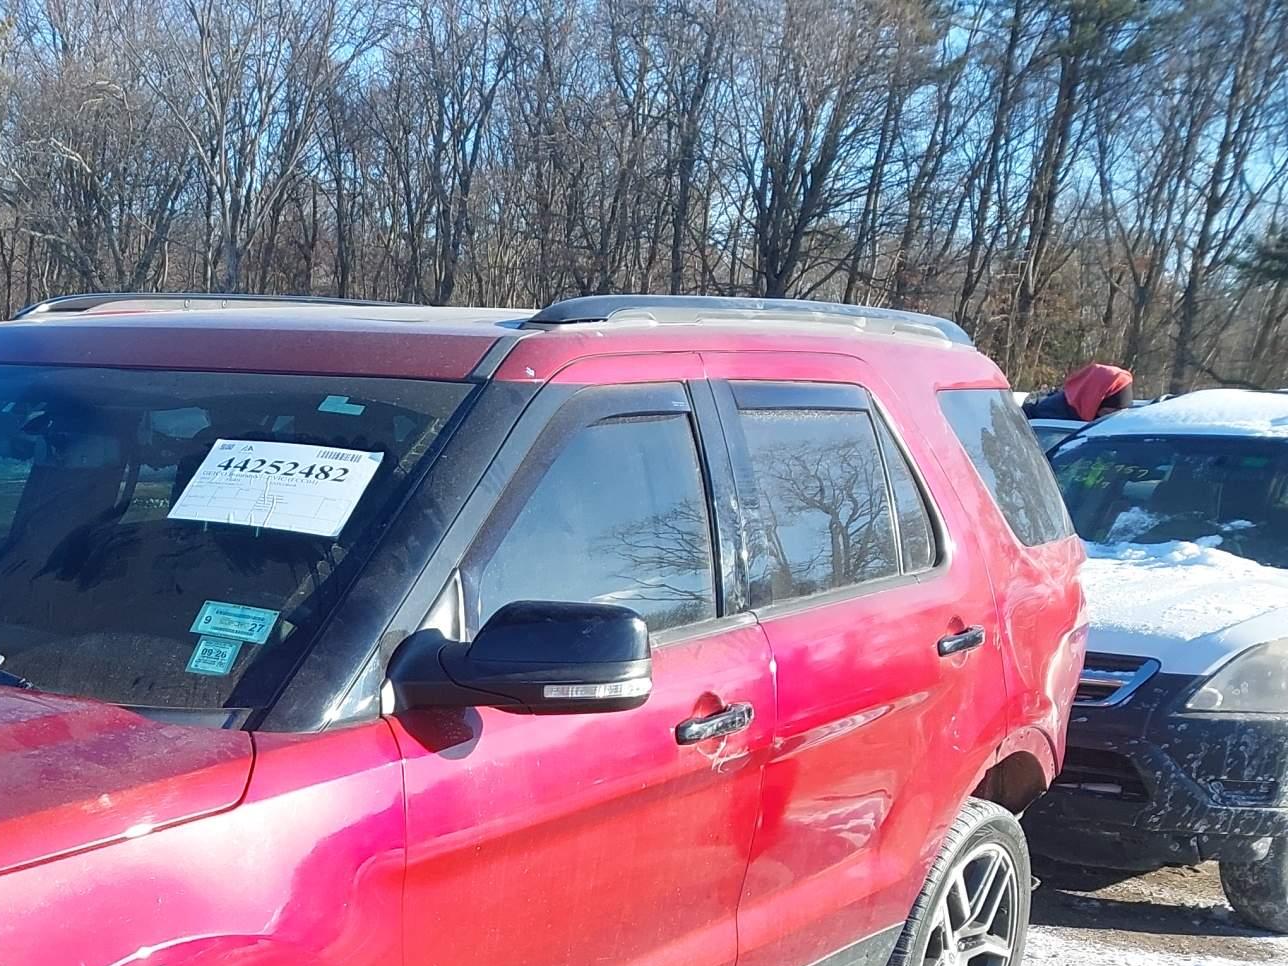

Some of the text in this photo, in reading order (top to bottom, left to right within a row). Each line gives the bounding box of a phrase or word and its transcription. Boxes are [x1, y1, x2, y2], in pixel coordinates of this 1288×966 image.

[217, 456, 349, 483] 44252482
[203, 615, 212, 625] 9
[248, 622, 266, 633] 27
[201, 647, 213, 657] 09
